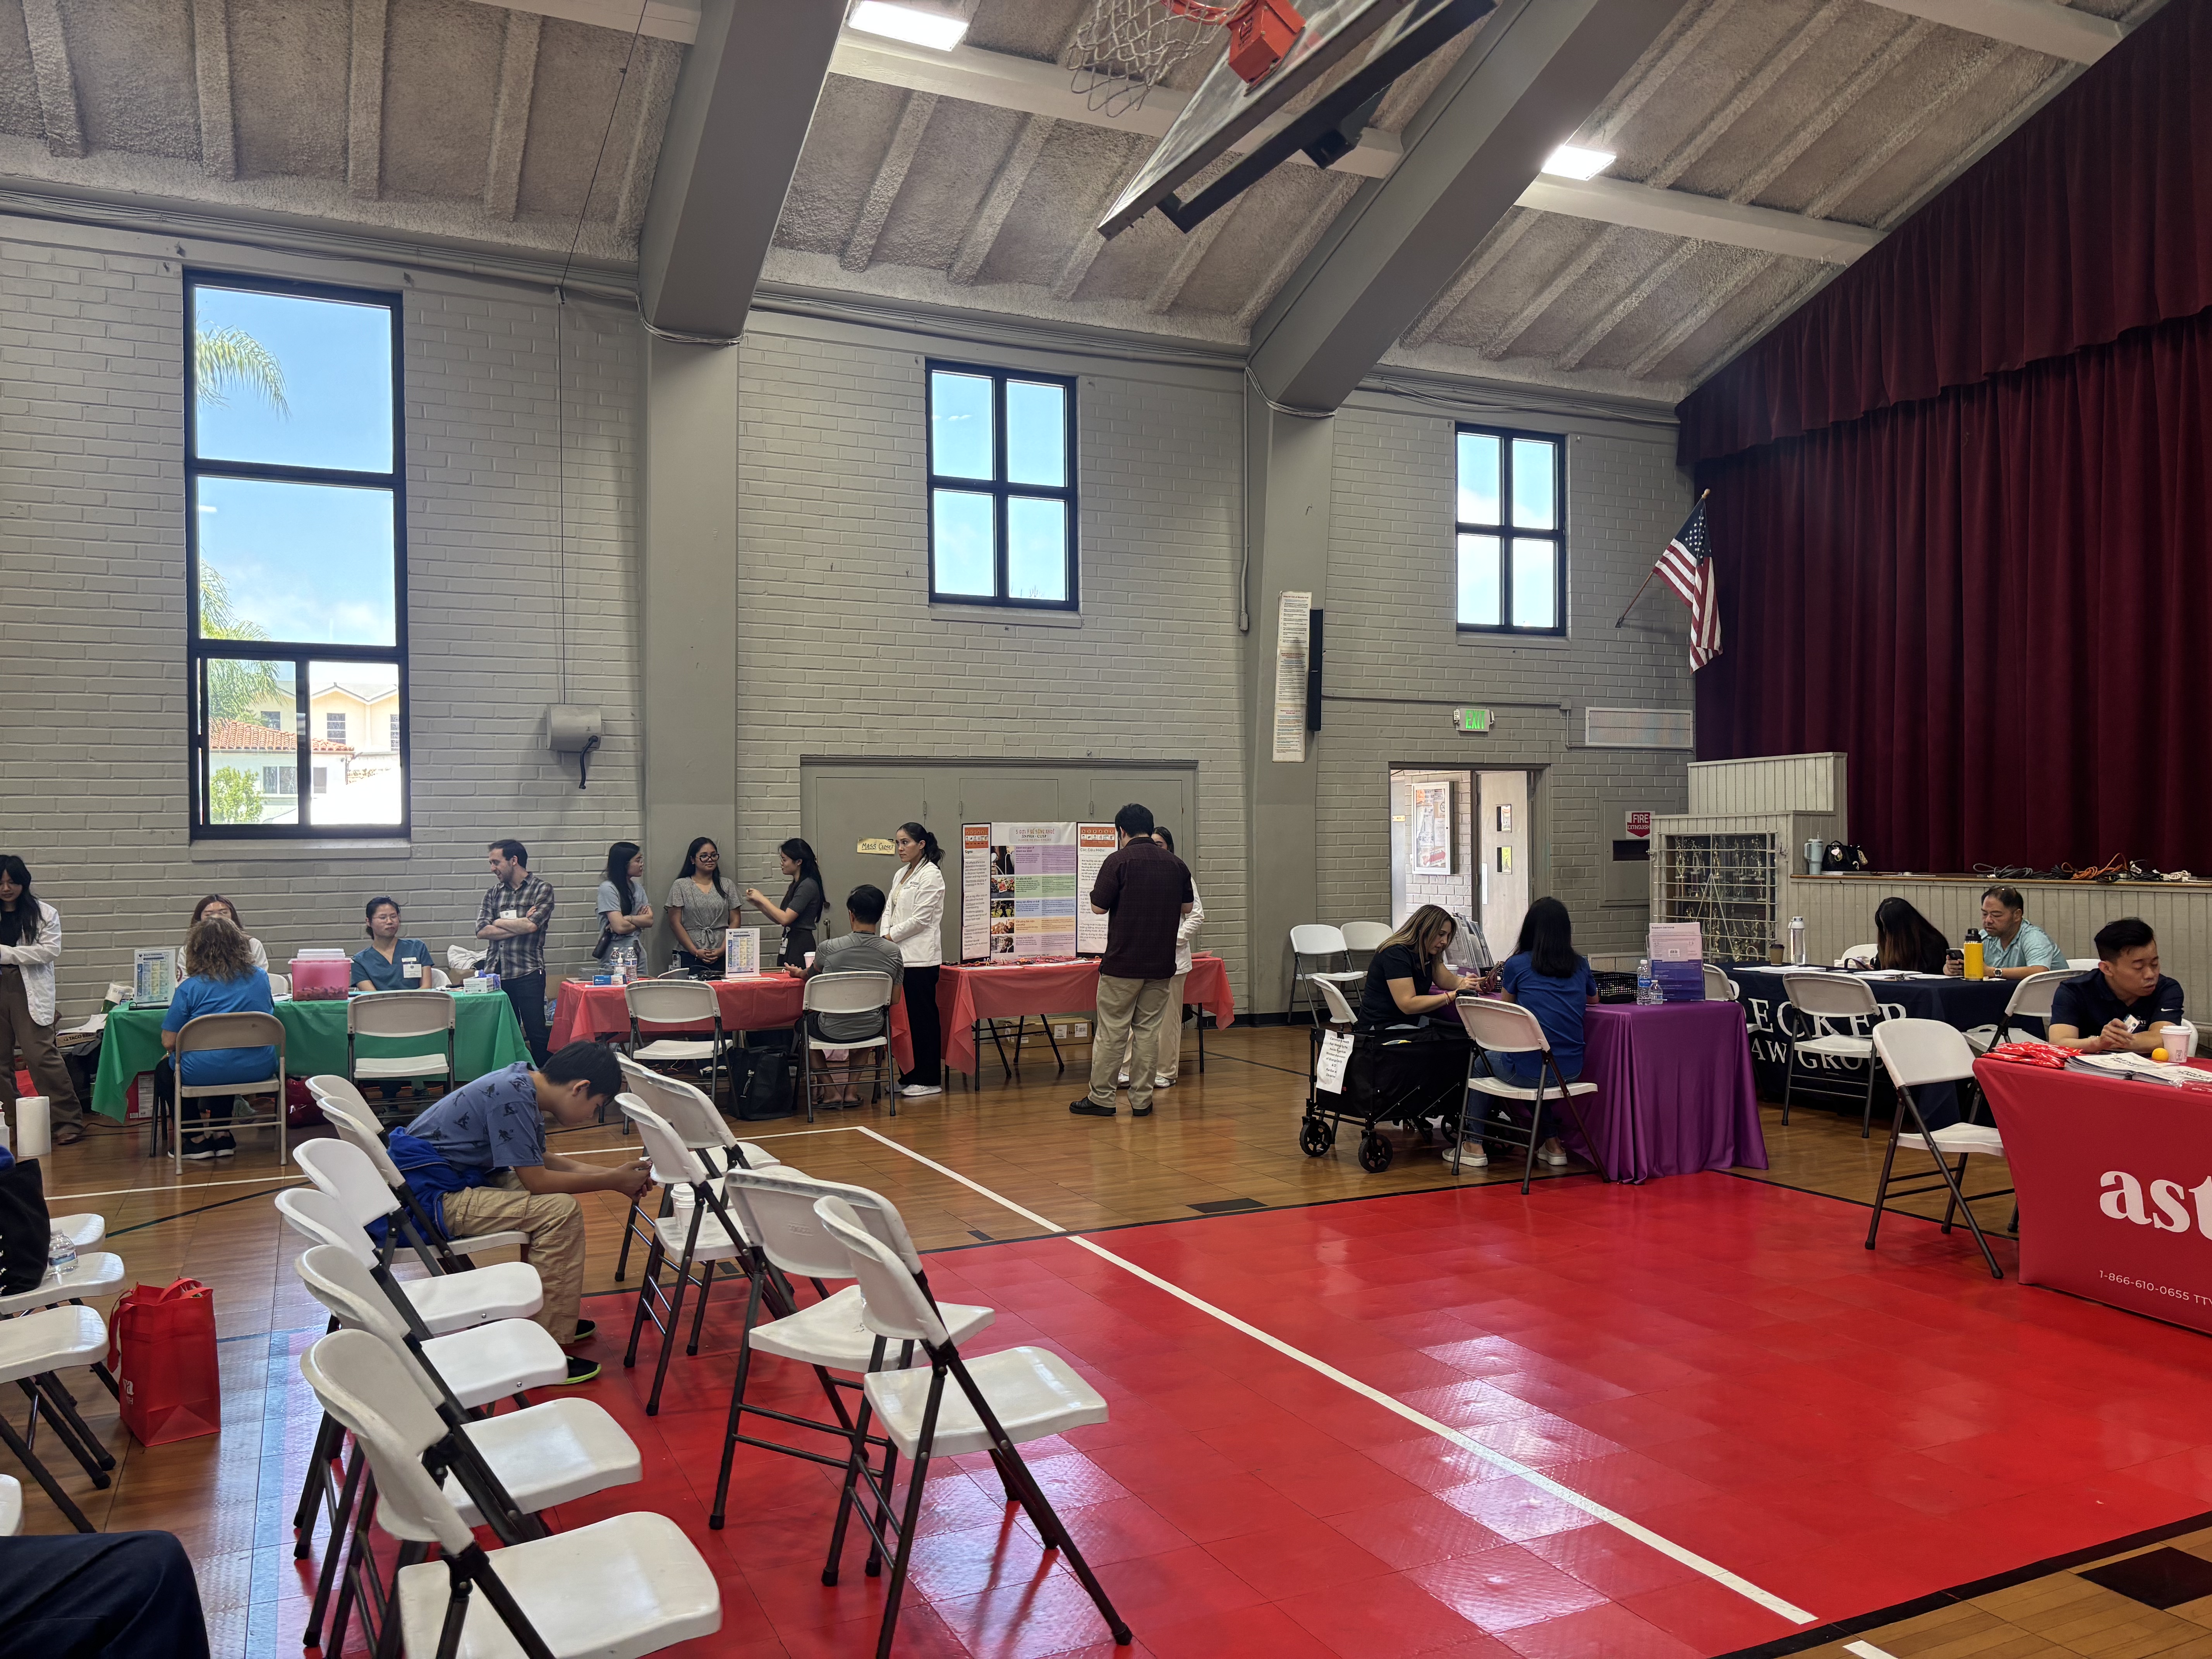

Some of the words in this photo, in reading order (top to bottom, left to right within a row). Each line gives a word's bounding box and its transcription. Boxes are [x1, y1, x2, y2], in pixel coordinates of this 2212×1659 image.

[1465, 709, 1485, 729] EXIT
[1633, 814, 1649, 823] FIRE
[1748, 998, 1906, 1038] ECKE
[1752, 1038, 1787, 1063] AW
[1798, 1050, 1884, 1070] GRO
[2099, 1270, 2189, 1300] 1-866-610-0655
